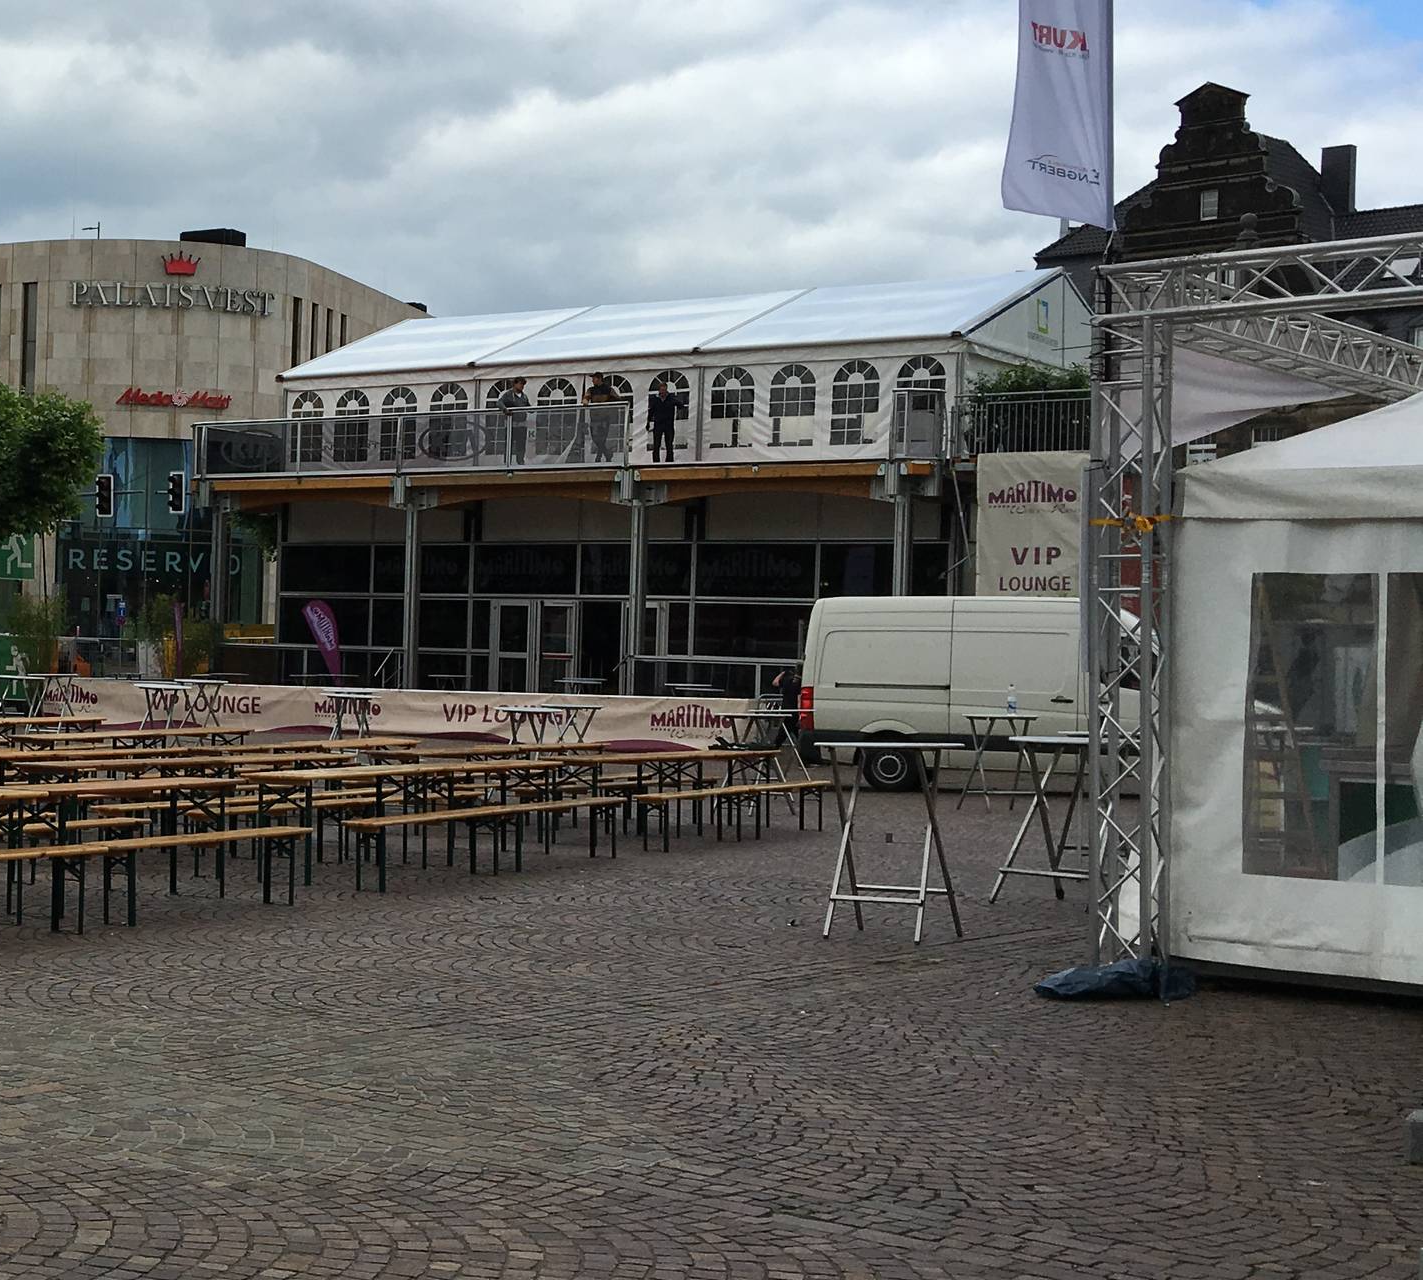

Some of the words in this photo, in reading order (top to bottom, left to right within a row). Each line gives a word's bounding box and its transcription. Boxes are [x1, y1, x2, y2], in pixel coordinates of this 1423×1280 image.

[988, 481, 1077, 504] MARITIMO
[1010, 547, 1062, 565] VIP
[999, 575, 1072, 592] LOUNGE
[185, 695, 261, 714] LOUNGE
[443, 703, 477, 722] VIP
